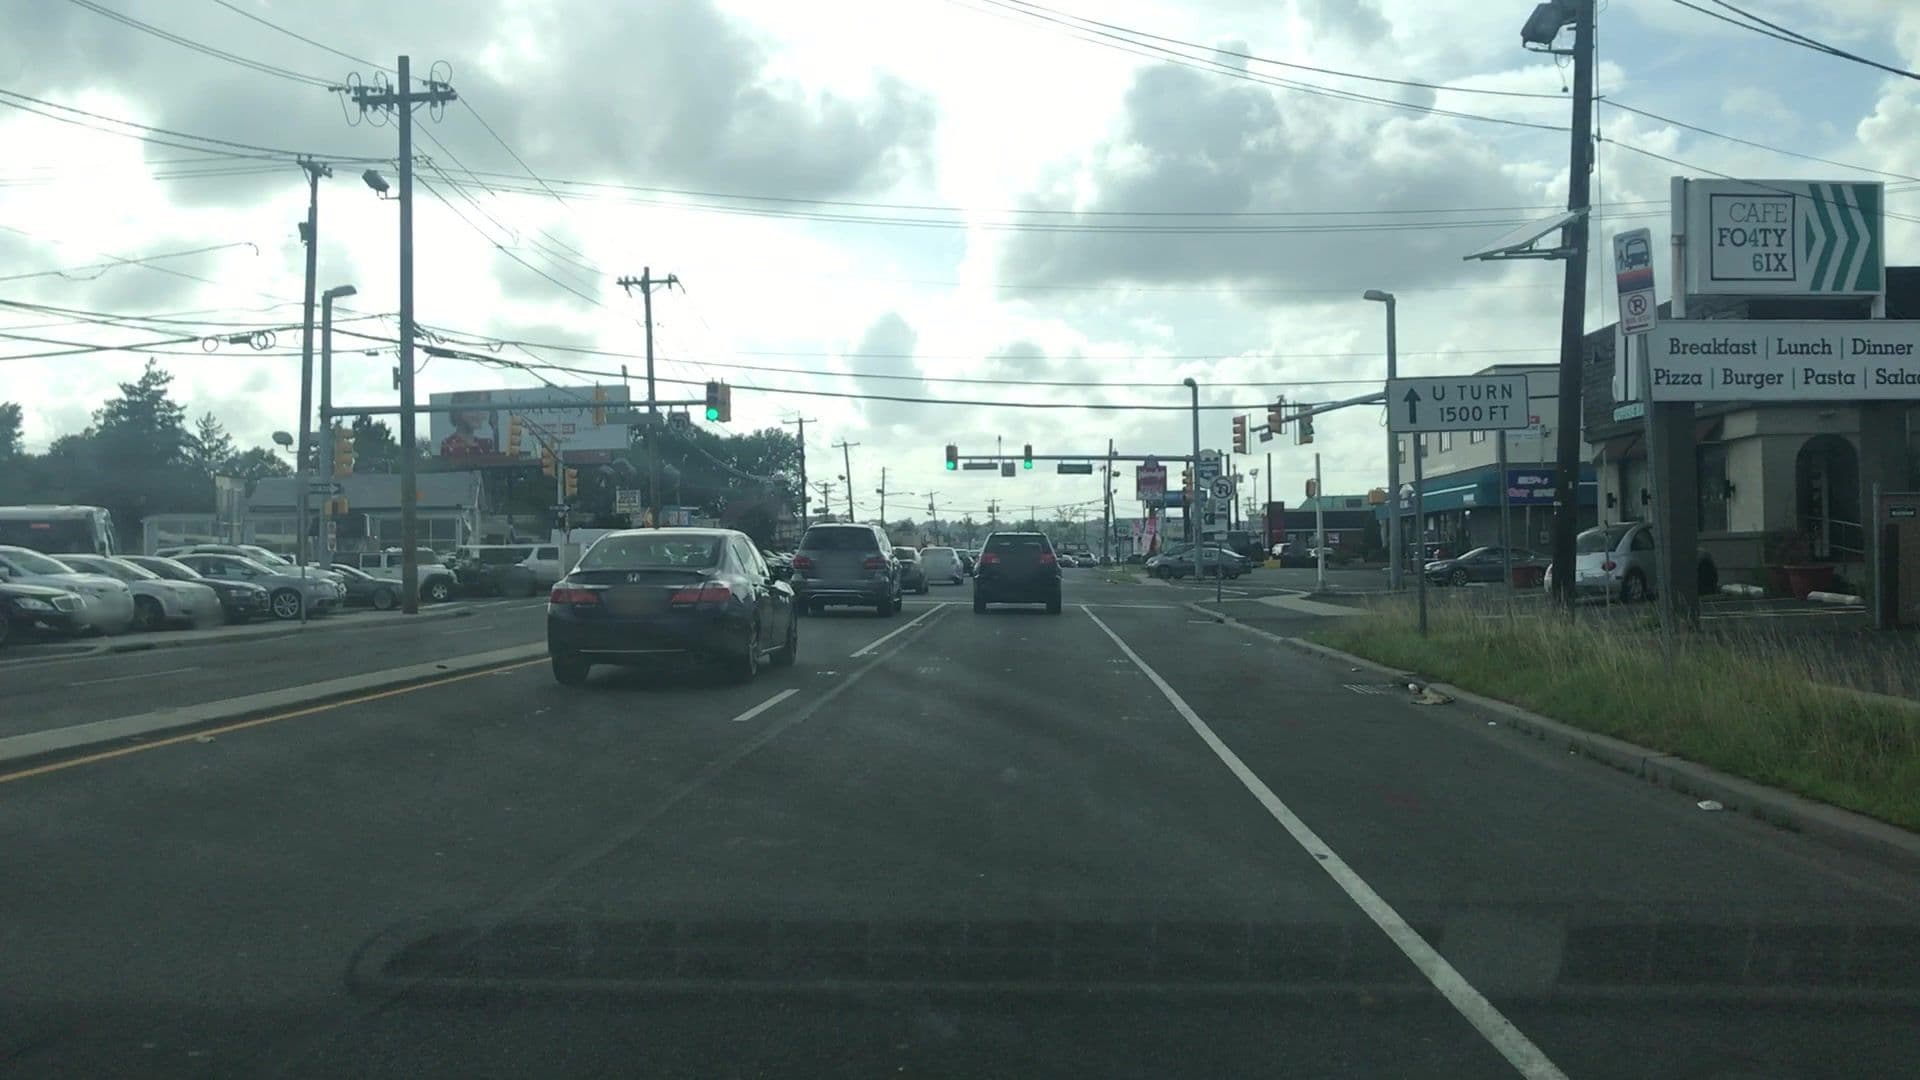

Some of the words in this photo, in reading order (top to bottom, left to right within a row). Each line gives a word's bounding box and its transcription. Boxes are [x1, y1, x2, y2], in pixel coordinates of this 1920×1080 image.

[1729, 202, 1787, 223] CAFE
[1717, 227, 1787, 248] FO4TY
[1752, 252, 1788, 272] 6IX
[1668, 337, 1758, 356] Breakfast
[1776, 337, 1833, 356] Lunch
[1851, 337, 1914, 356] Dinner
[1653, 367, 1703, 386] Pizza
[1722, 367, 1785, 390] Burger
[1803, 367, 1856, 386] Pasta
[1432, 385, 1446, 401] U
[1456, 383, 1513, 401] TURN
[1440, 406, 1483, 422] 1500
[1488, 405, 1510, 420] FT
